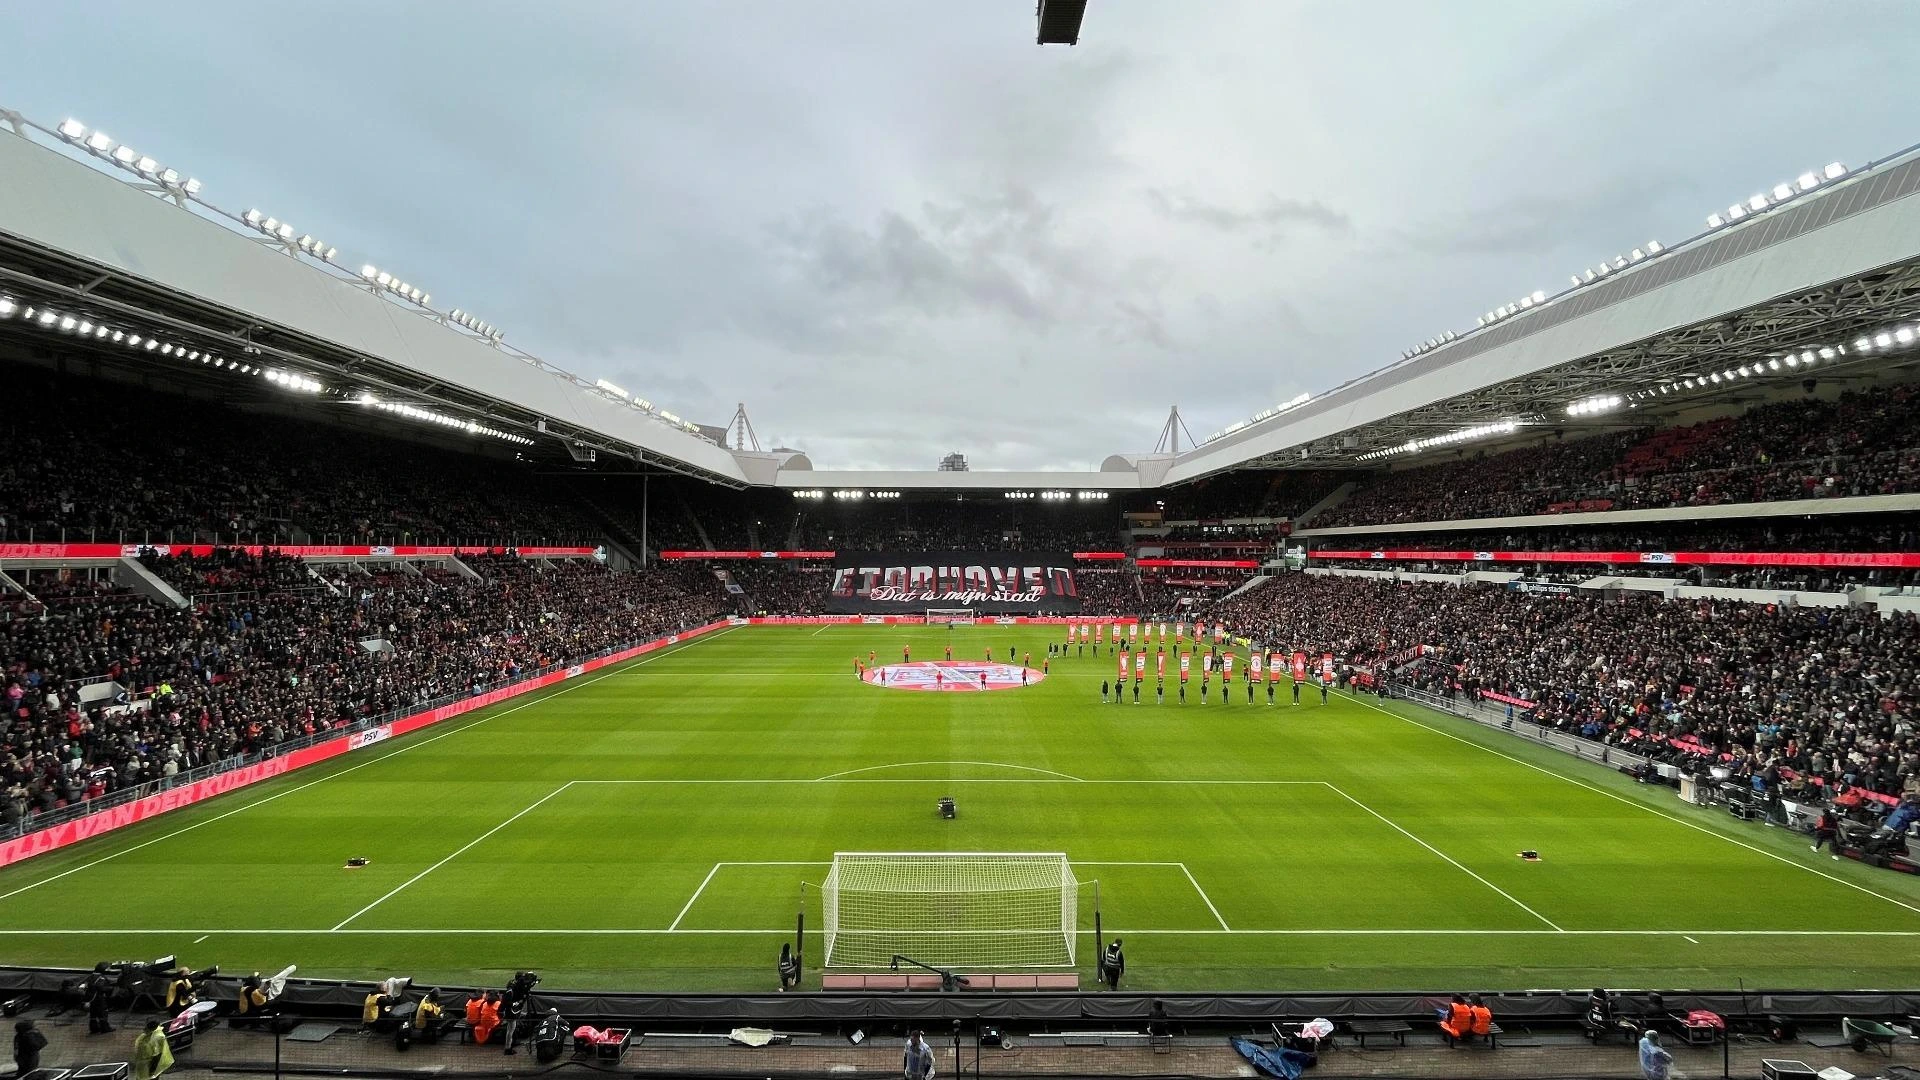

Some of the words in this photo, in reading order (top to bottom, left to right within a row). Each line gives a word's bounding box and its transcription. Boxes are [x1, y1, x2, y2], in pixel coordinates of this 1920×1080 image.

[870, 586, 917, 602] Dat
[920, 590, 941, 601] is
[942, 588, 992, 605] mijn
[992, 586, 1041, 602] stad
[1529, 584, 1548, 592] philips
[363, 730, 379, 743] PSV
[75, 803, 138, 841] VAN
[139, 785, 197, 823] DER
